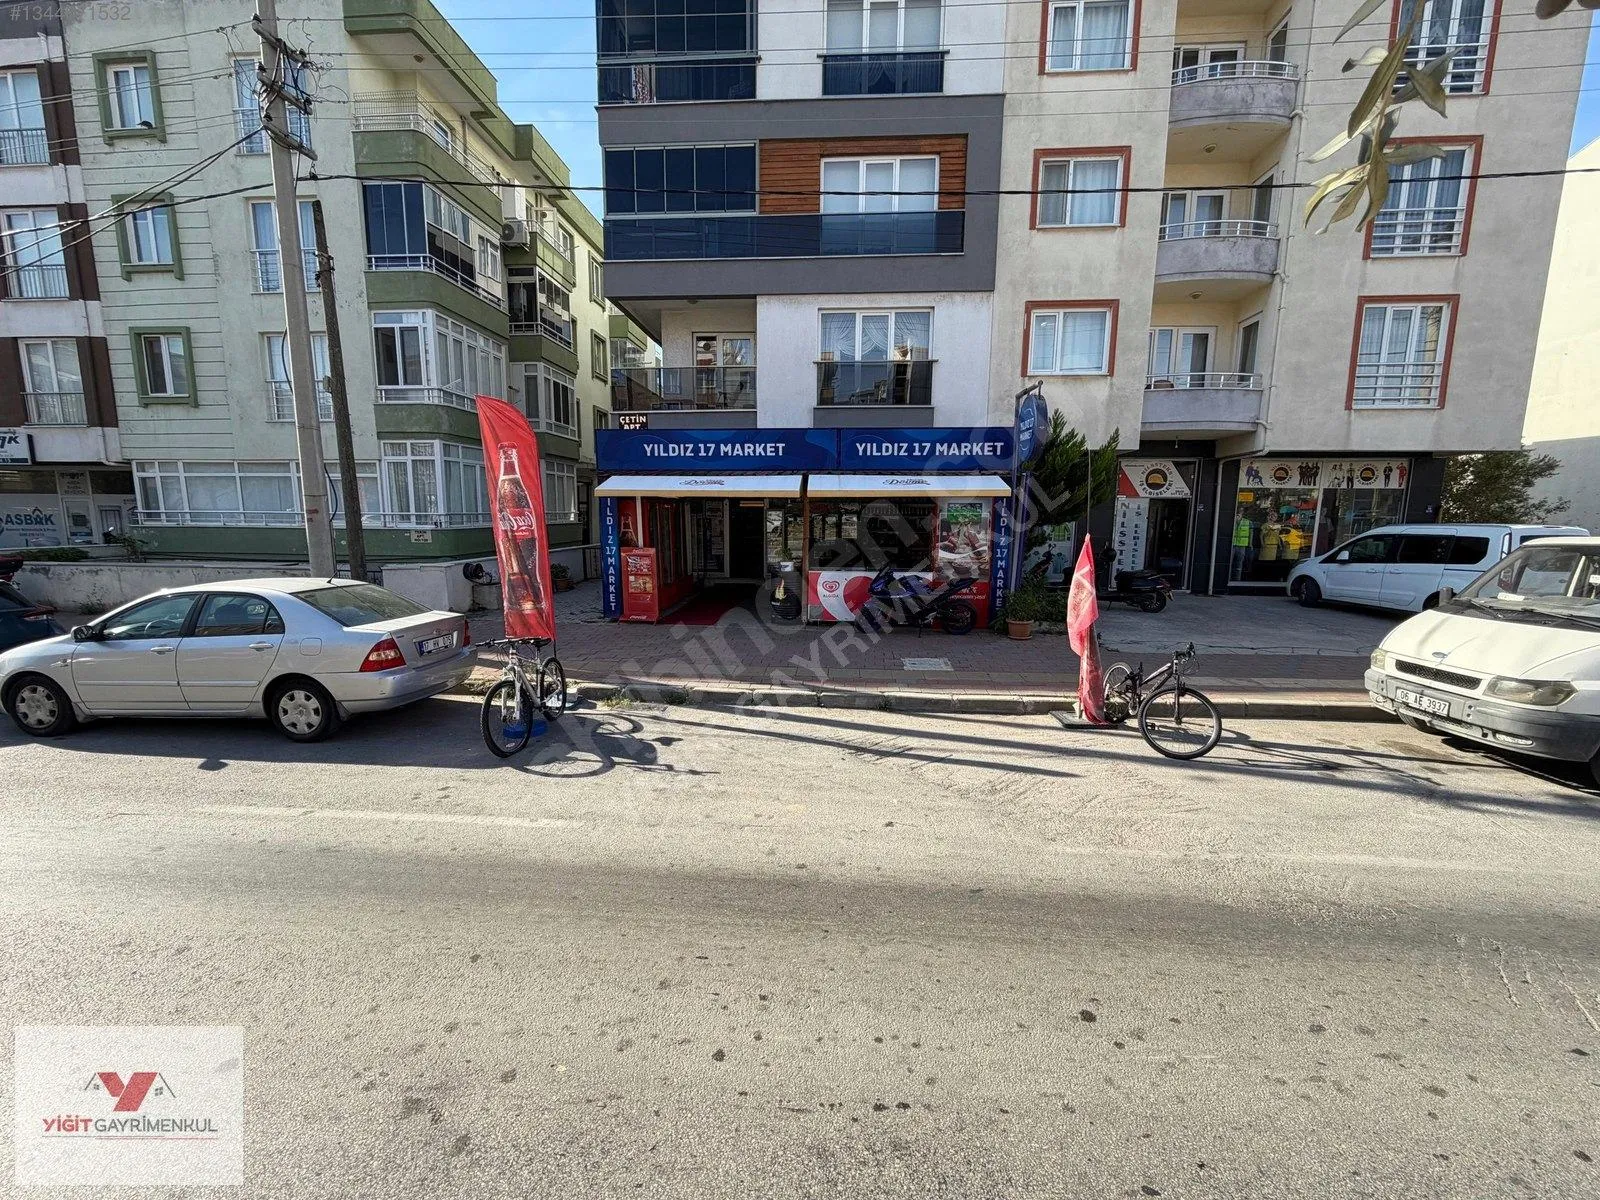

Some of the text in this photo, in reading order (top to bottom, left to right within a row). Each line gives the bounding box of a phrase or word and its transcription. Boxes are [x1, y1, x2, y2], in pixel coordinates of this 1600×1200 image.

[620, 414, 646, 425] ÇETİN
[643, 443, 786, 457] YILDIZ 17 MARKET
[855, 442, 1004, 456] YILDIZ 17 MARKET
[1000, 497, 1008, 546] ILDIZ
[605, 546, 616, 555] 17
[996, 548, 1007, 557] 17
[607, 557, 617, 611] MARKET
[996, 559, 1006, 610] MARKE
[1400, 690, 1447, 712] 06 AE 3937
